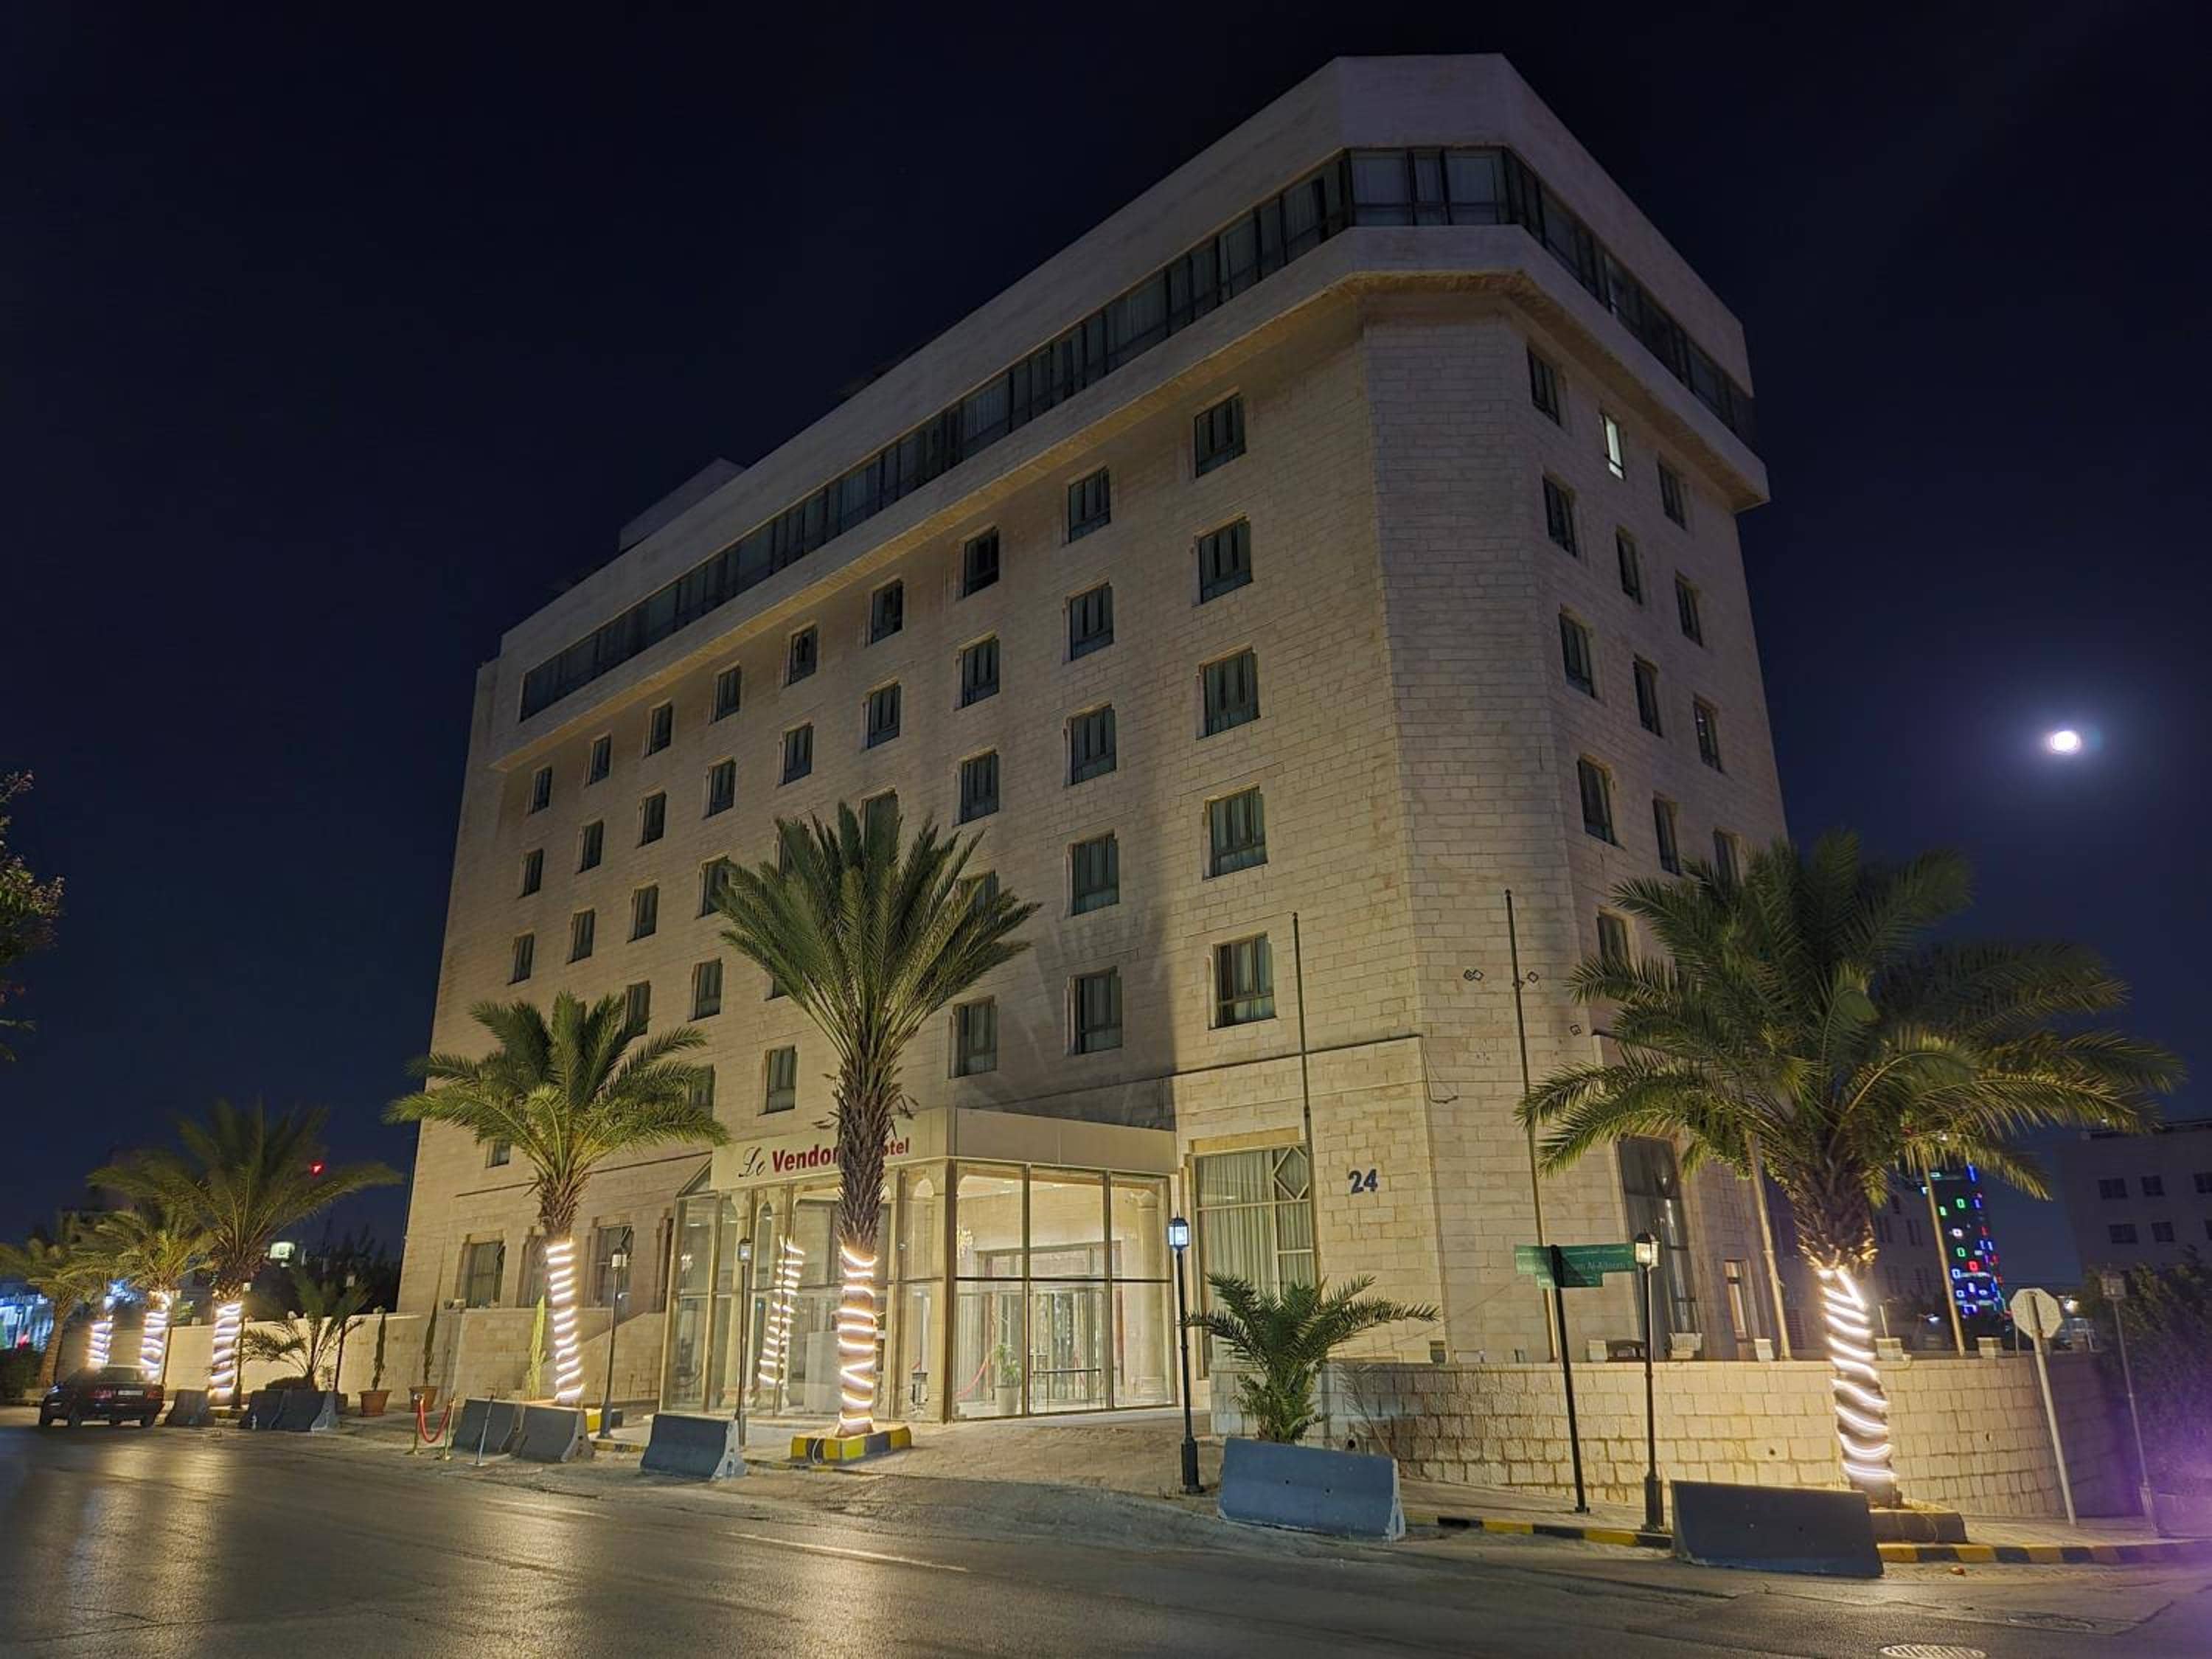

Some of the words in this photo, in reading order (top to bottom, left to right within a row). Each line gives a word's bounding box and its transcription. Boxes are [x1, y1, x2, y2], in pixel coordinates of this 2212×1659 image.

[738, 1147, 766, 1178] Le
[772, 1144, 839, 1172] Vendo
[883, 1136, 909, 1156] otel
[1348, 1168, 1378, 1194] 24
